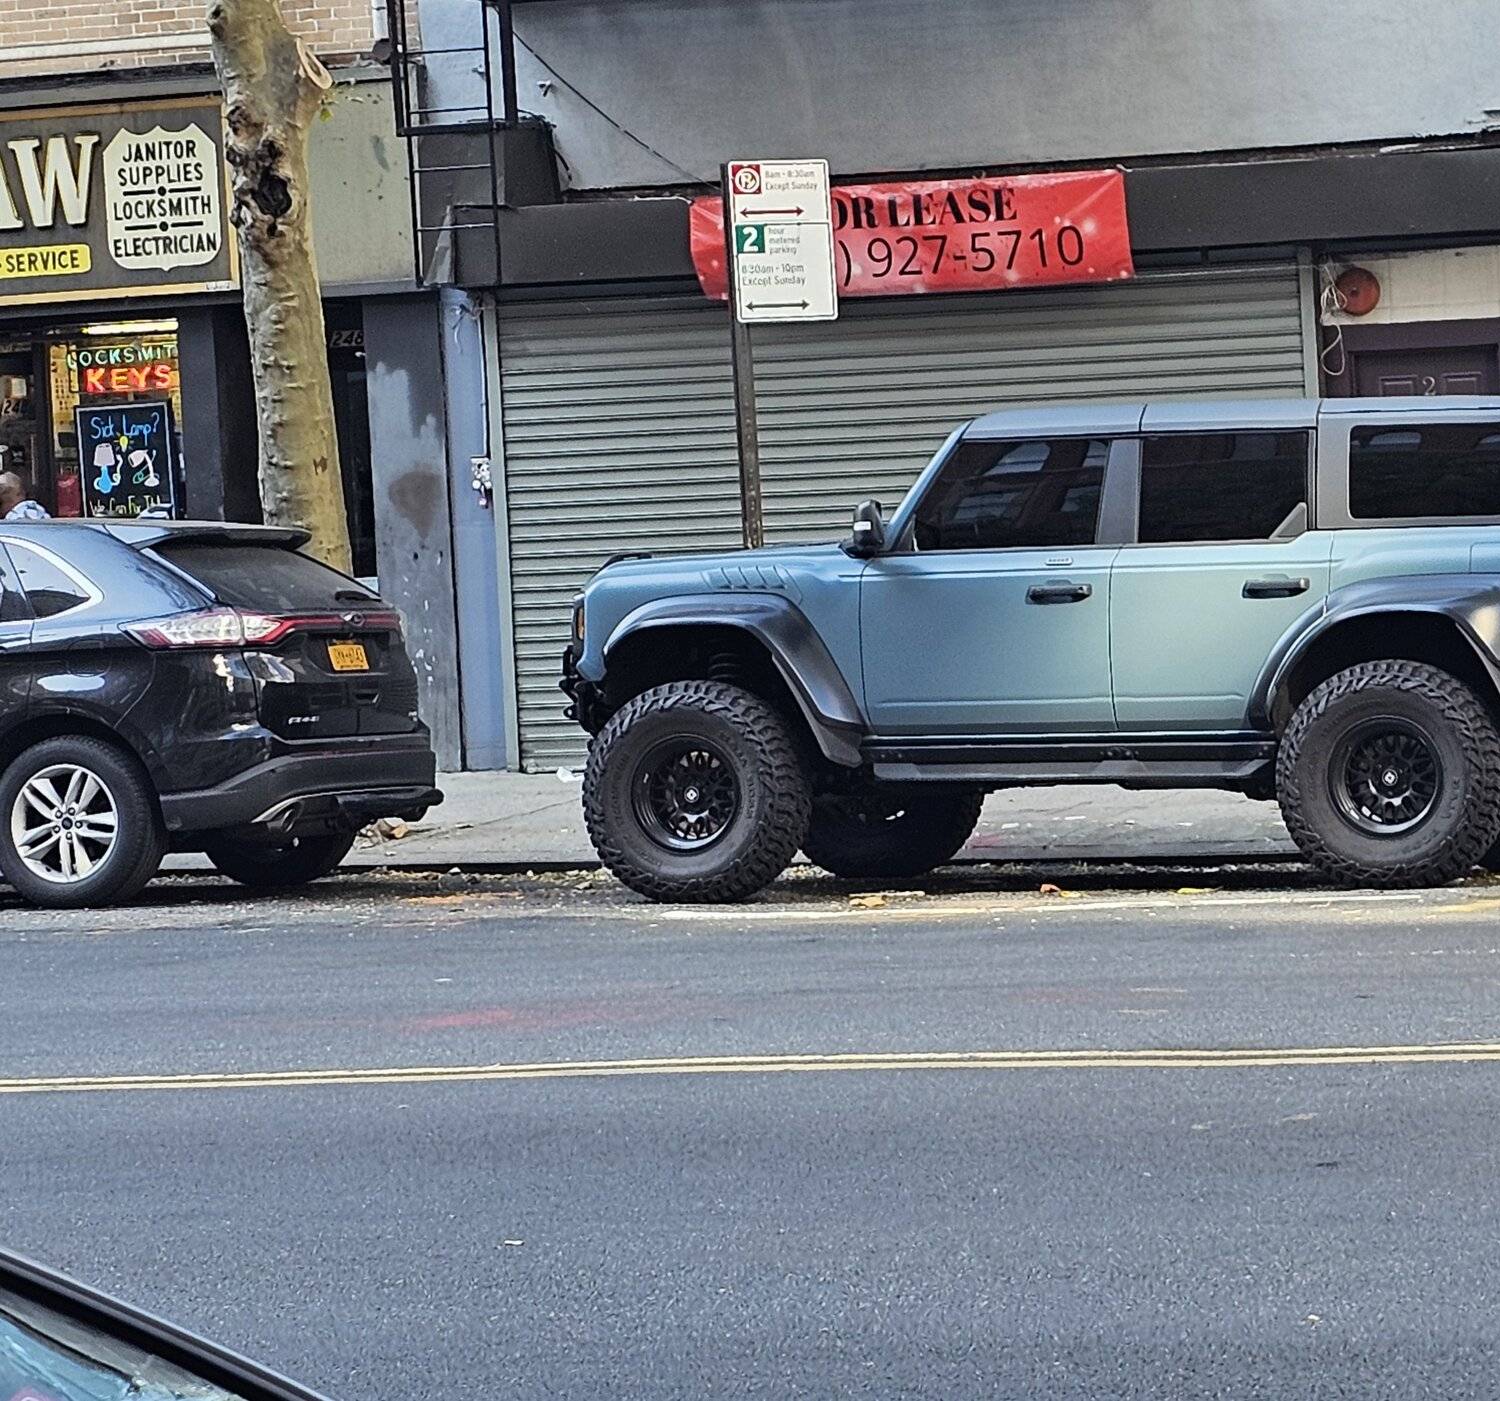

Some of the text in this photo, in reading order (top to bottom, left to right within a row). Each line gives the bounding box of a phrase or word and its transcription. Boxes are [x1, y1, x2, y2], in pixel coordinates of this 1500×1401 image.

[122, 140, 197, 162] JANITOR
[0, 134, 99, 229] W
[118, 162, 203, 186] SUPPLIES
[765, 182, 818, 191] Except Sunday
[114, 195, 212, 221] LOCKSMITH
[832, 188, 1018, 231] OR LEASE
[114, 233, 217, 258] ELECTRICIAN
[742, 226, 759, 253] 2
[769, 247, 797, 255] parking
[867, 224, 1085, 278] 927-5710
[6, 250, 80, 273] SERVICE
[781, 263, 804, 274] 10pm
[742, 275, 806, 287] Except Sunday
[67, 344, 176, 369] LOCKSMIT
[86, 364, 172, 393] KEYS
